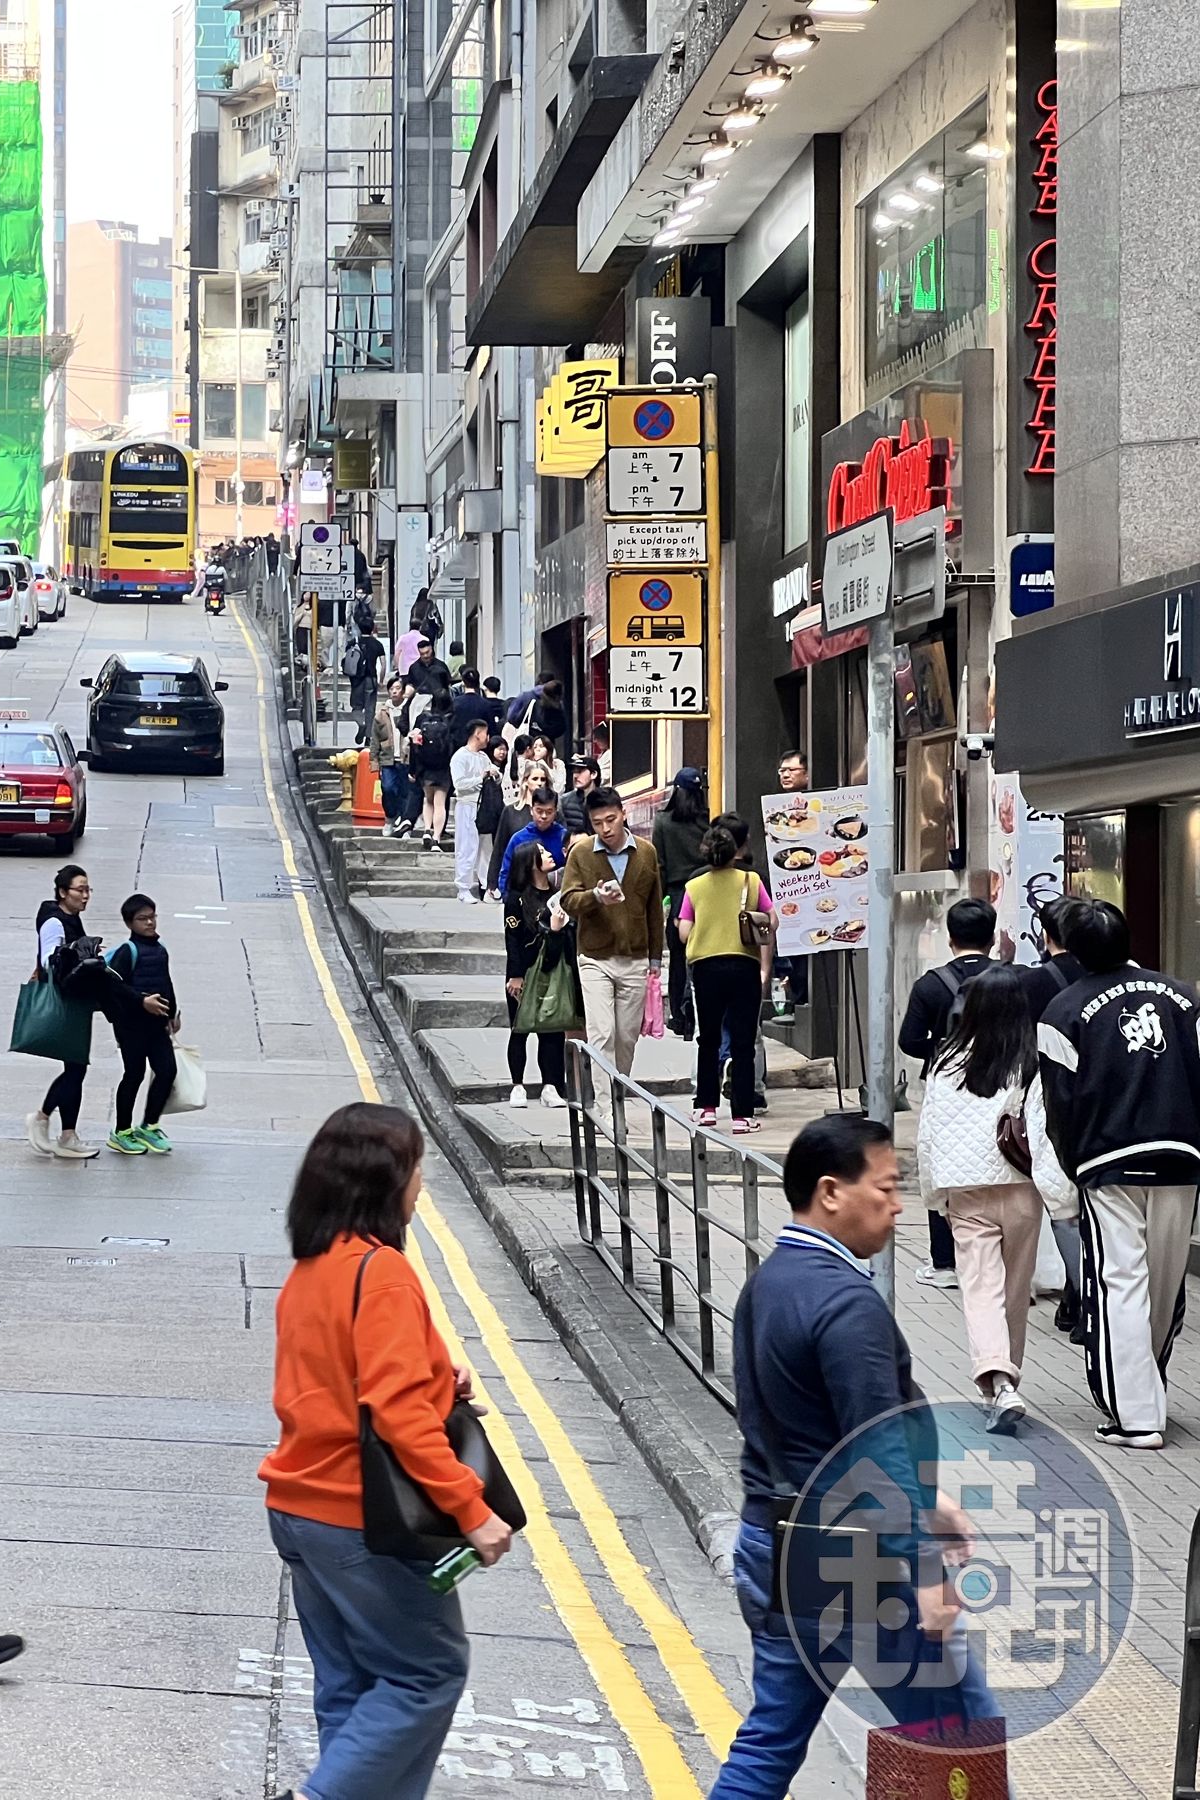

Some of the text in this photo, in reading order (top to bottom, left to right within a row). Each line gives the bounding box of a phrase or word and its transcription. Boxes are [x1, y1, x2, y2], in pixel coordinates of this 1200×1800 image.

[627, 462, 654, 474] 上午
[632, 451, 684, 473] am 7
[628, 496, 654, 508] 下午
[632, 485, 685, 507] pm 7
[629, 525, 684, 535] Except taxi
[617, 536, 695, 546] pick up/drop off
[325, 548, 334, 558] 7
[612, 548, 700, 560] 的士上落客除外
[325, 562, 333, 571] 7
[340, 575, 348, 585] 7
[342, 590, 353, 599] 12
[626, 660, 652, 672] 上午
[630, 650, 683, 672] am 7
[615, 683, 697, 708] midnight 12
[626, 696, 653, 708] 午夜
[1123, 687, 1200, 728] HAHAHAFLO
[775, 879, 831, 900] Brunch Set
